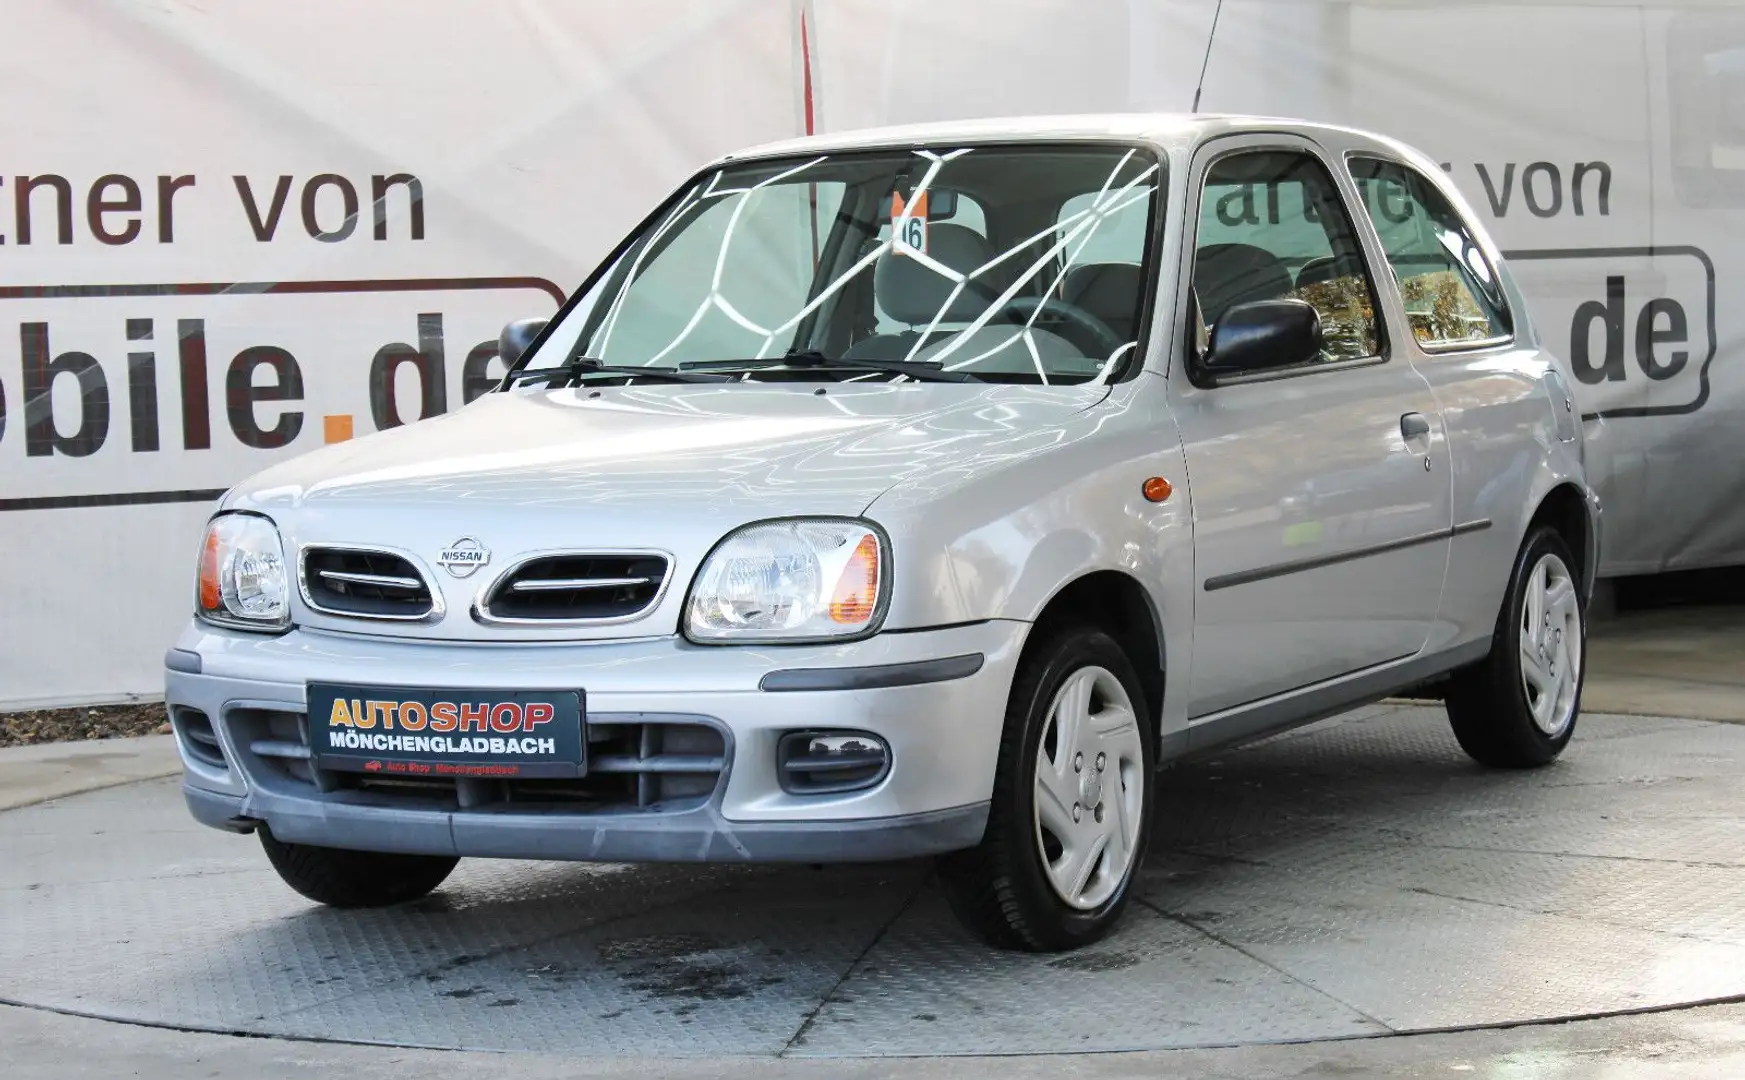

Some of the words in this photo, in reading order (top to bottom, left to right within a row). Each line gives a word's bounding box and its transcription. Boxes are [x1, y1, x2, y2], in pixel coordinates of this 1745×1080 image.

[0, 173, 195, 245] ner
[233, 173, 425, 243] von
[1474, 161, 1612, 218] von
[1570, 275, 1689, 385] de
[0, 313, 504, 458] bile.d
[441, 551, 482, 561] NISSAN
[329, 698, 555, 733] AUTOSHOP
[329, 729, 556, 754] MÖNCHENGLADBACH
